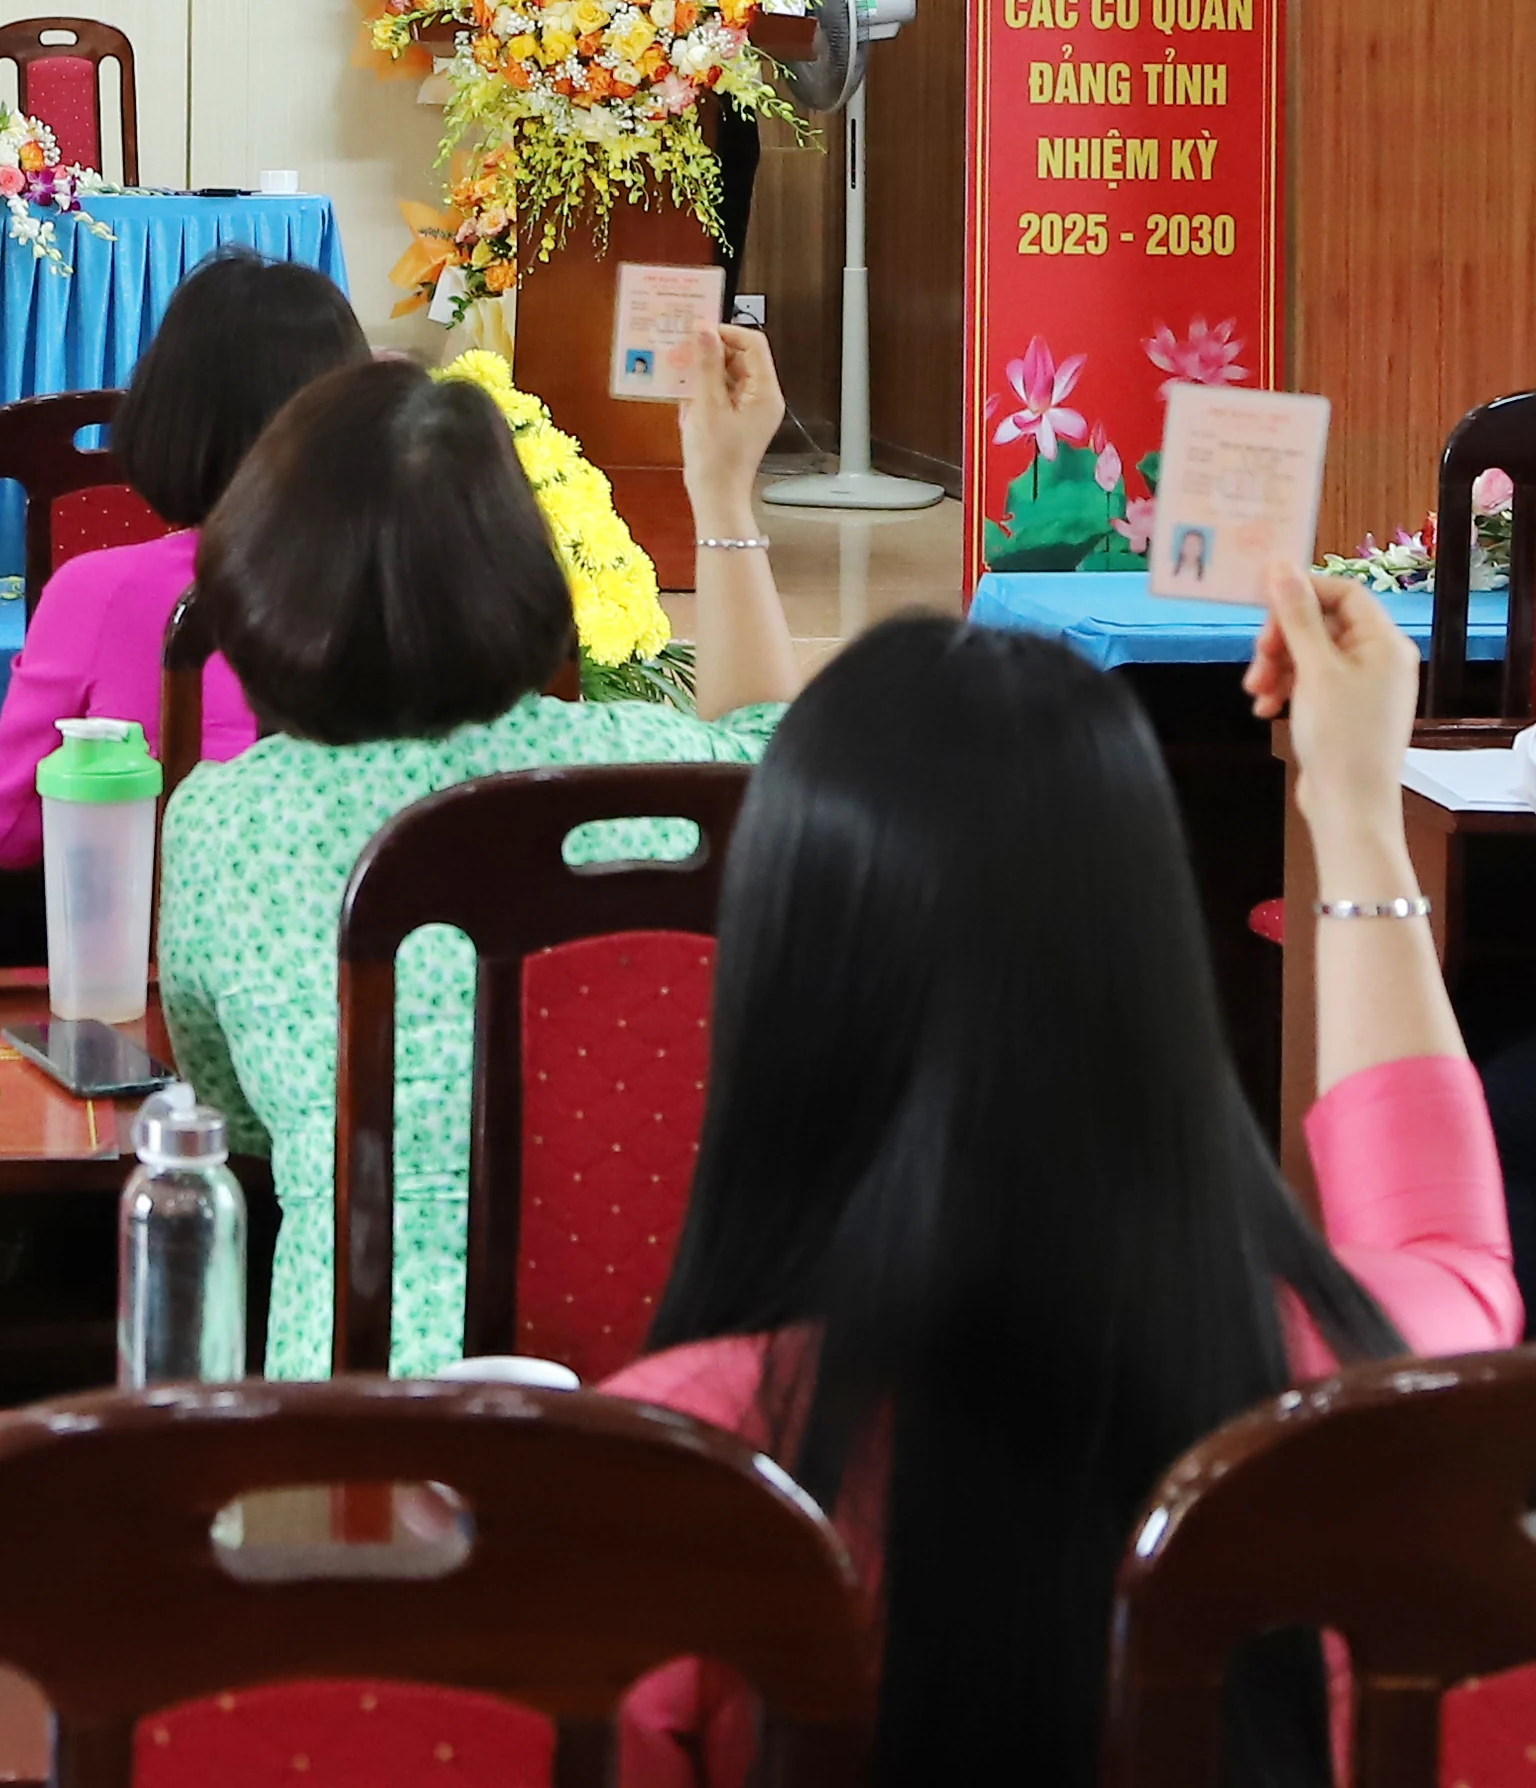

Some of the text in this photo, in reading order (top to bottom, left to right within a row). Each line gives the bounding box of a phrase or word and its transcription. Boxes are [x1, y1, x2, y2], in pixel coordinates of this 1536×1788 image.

[1028, 44, 1227, 106] ĐẢNG TỈNH
[1037, 129, 1218, 189] NHIỆM KỲ
[1018, 212, 1235, 256] 2025 - 2030
